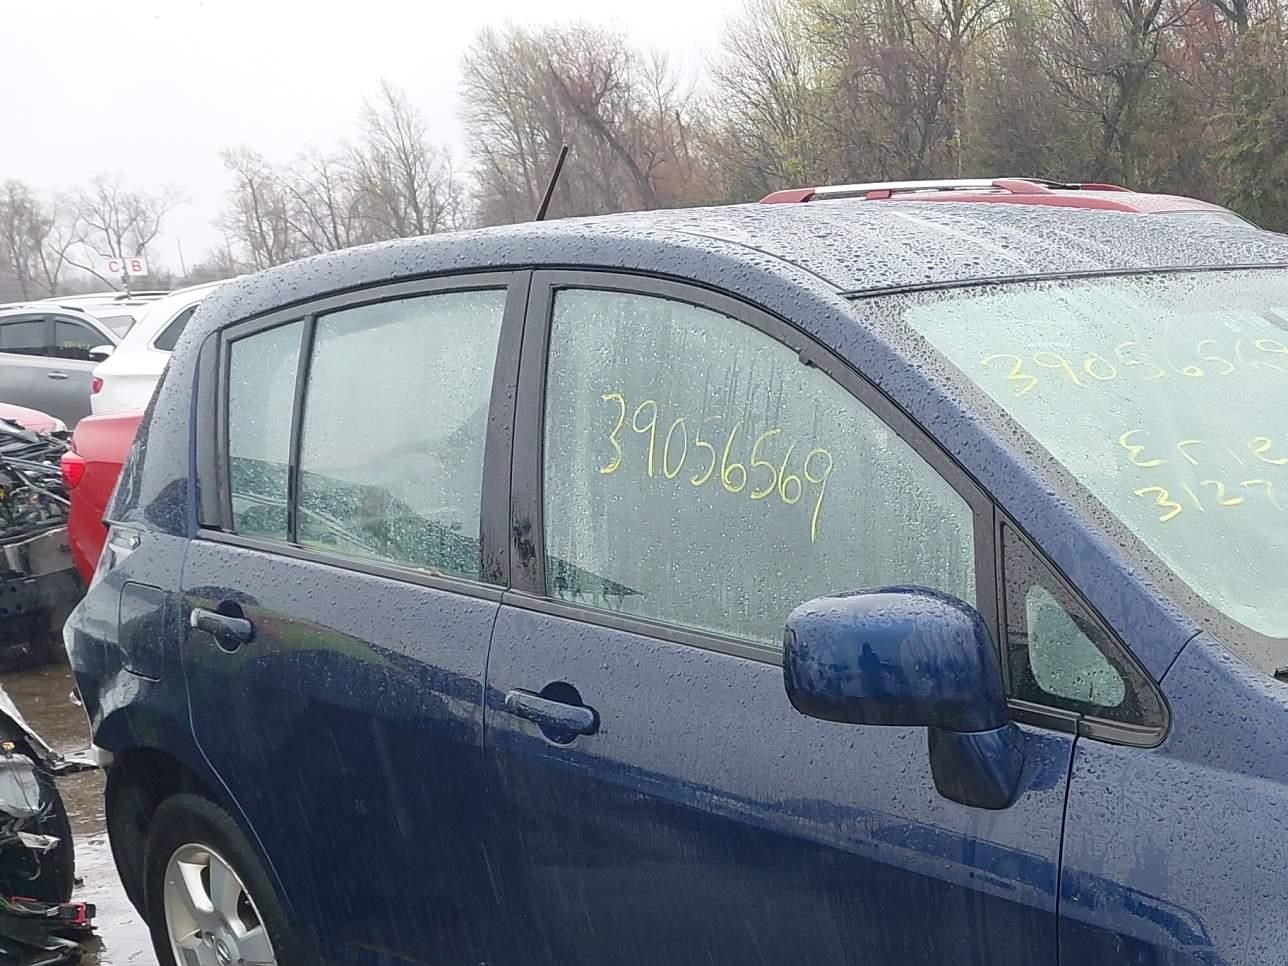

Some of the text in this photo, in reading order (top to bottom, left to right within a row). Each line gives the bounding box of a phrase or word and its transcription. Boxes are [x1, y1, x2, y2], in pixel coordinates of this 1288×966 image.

[108, 260, 119, 273] C
[131, 260, 142, 272] B
[600, 392, 833, 544] 39056569
